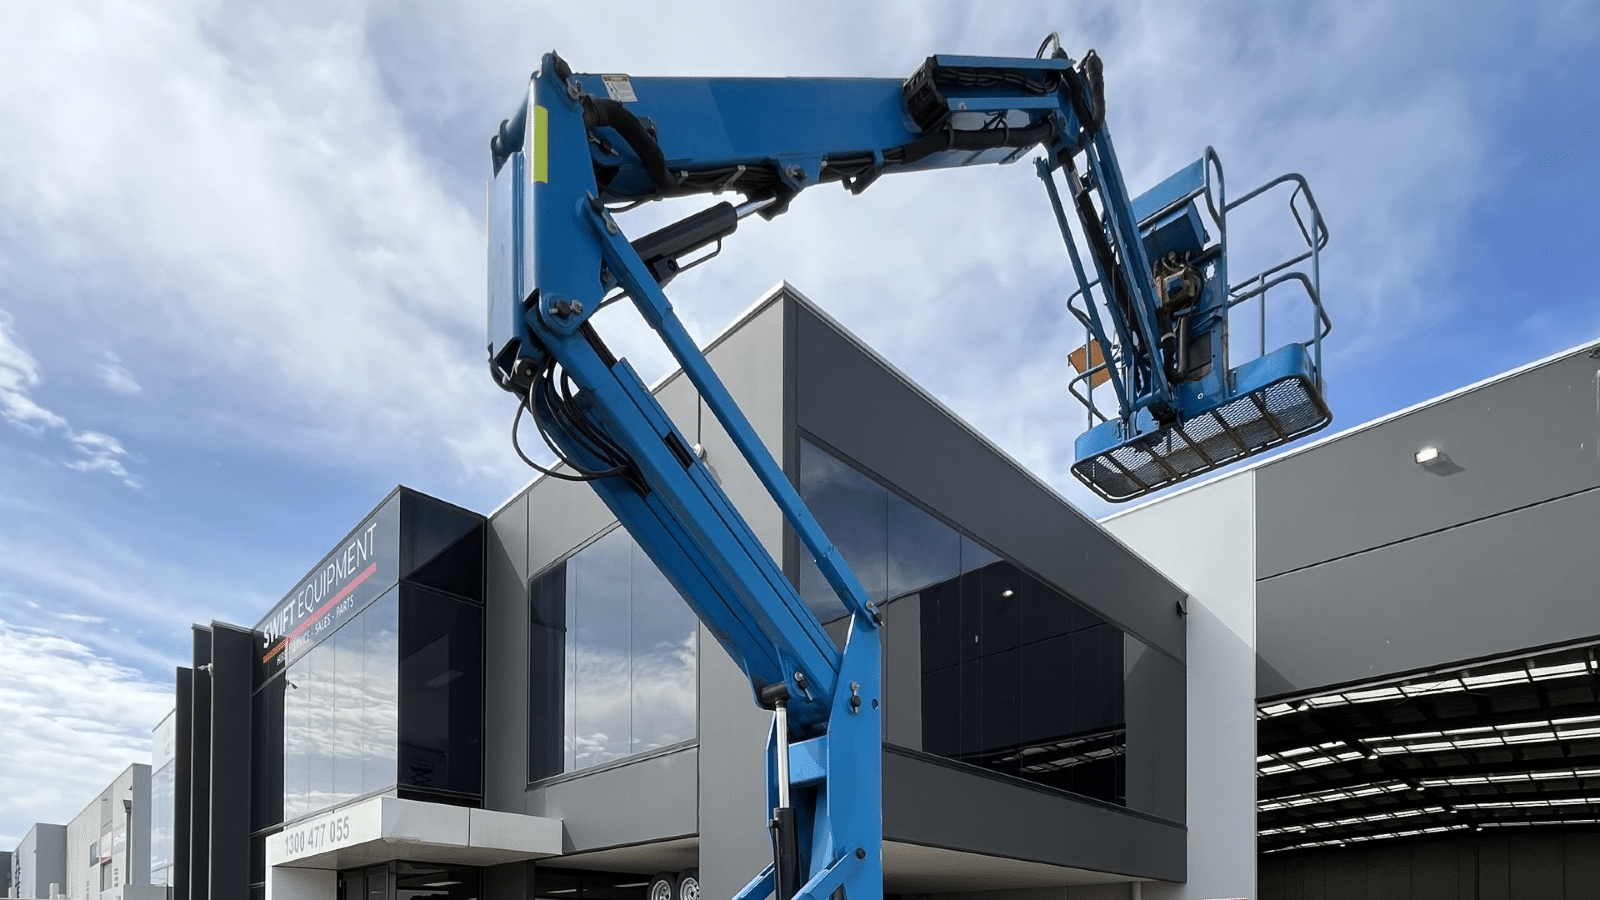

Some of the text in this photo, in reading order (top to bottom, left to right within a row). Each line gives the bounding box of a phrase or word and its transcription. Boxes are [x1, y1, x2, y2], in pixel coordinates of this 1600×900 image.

[263, 522, 377, 649] SWIFT EQUIPMENT
[315, 613, 331, 635] SALES
[336, 594, 354, 618] PARTS
[285, 816, 350, 856] 1300 477 055
